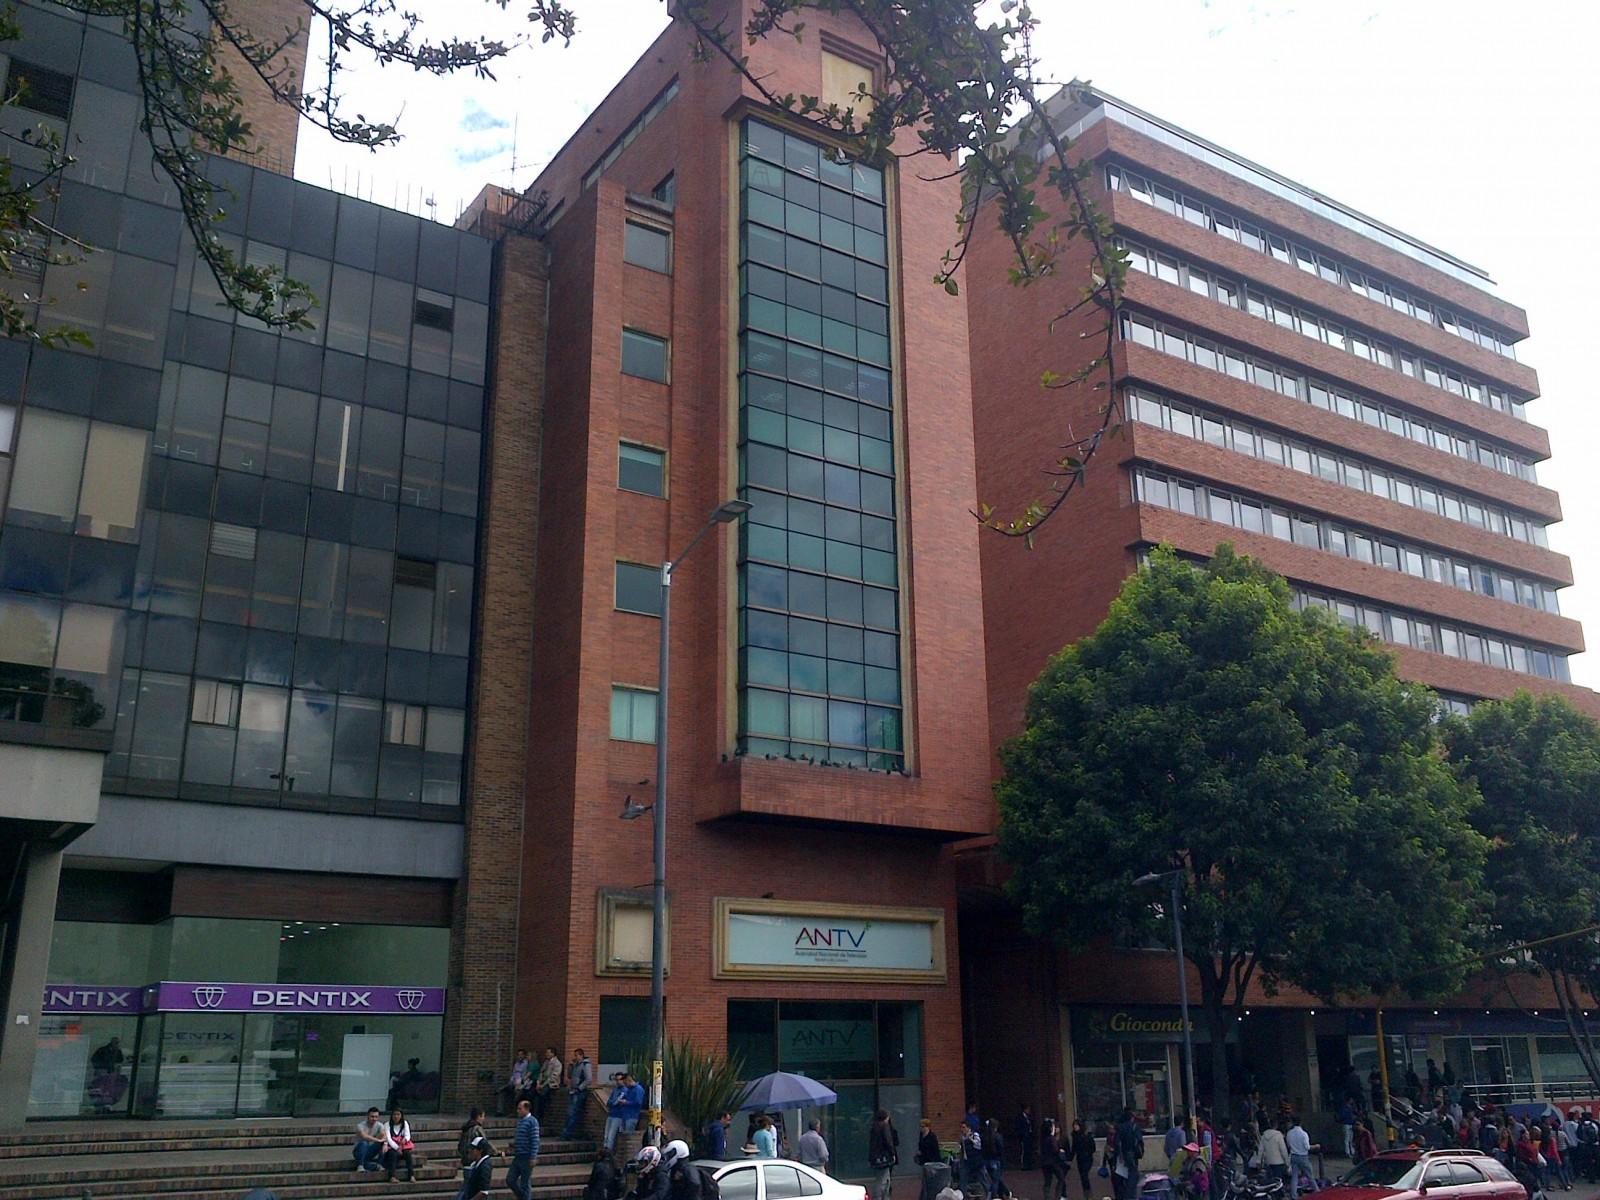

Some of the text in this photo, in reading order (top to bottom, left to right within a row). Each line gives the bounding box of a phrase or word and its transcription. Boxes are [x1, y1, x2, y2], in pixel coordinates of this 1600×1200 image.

[795, 927, 866, 948] ANTV
[43, 990, 131, 1007] NTIX
[252, 990, 371, 1007] DENTIX
